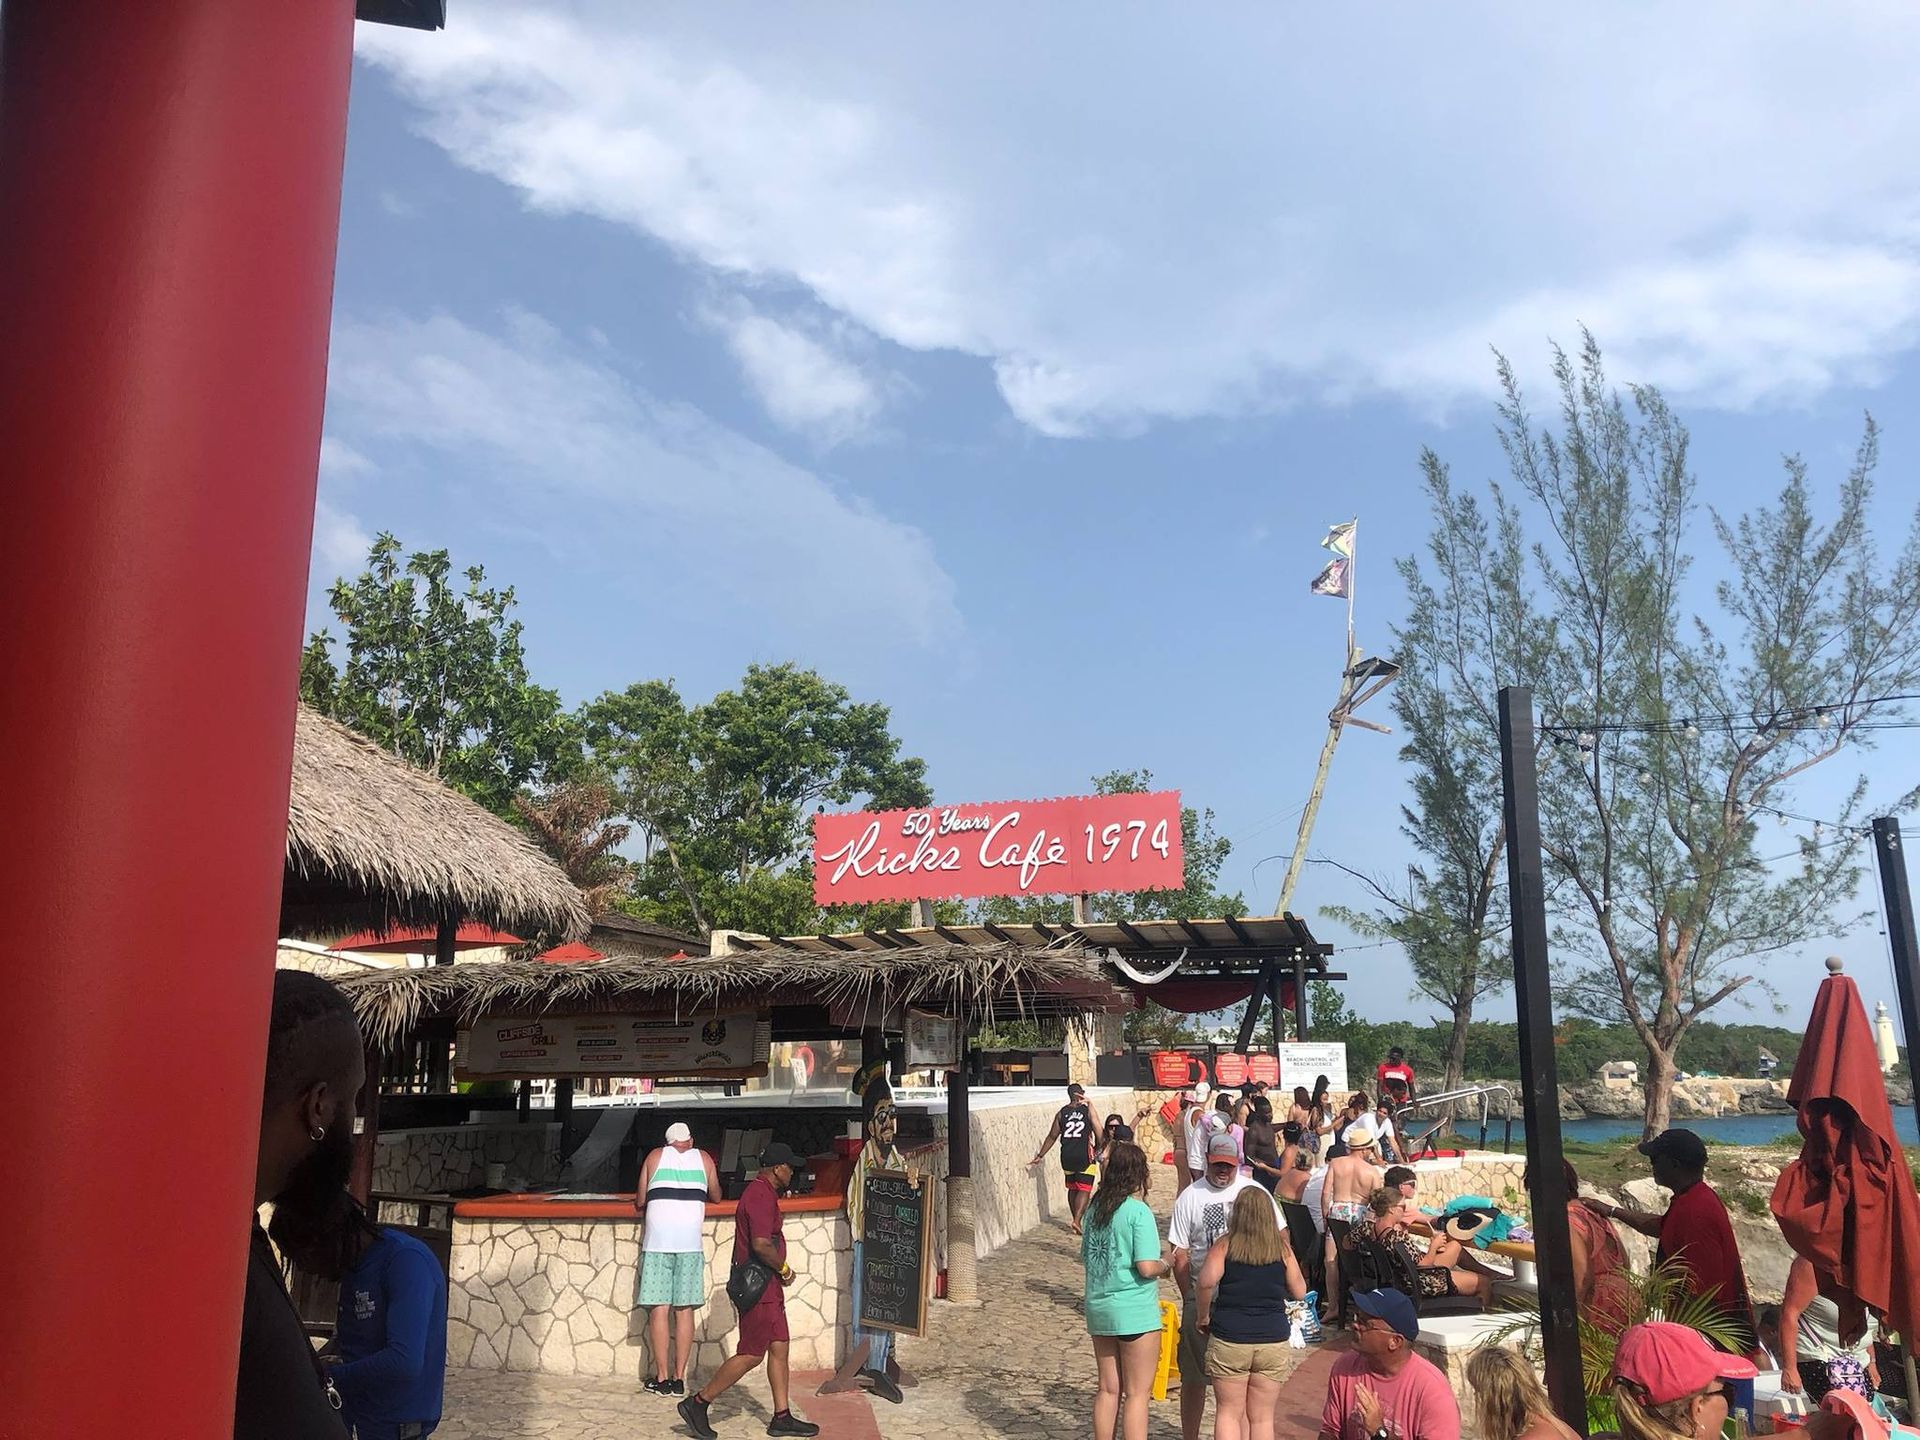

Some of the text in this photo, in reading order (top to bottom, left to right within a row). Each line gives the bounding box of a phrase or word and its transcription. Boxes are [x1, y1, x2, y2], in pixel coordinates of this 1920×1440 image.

[902, 809, 991, 835] 50 Years
[979, 811, 1068, 889] Café
[1085, 818, 1169, 863] 1974
[499, 1025, 541, 1040] CLIFFSIDE
[531, 1035, 557, 1046] GRILL
[1063, 1121, 1085, 1138] 22
